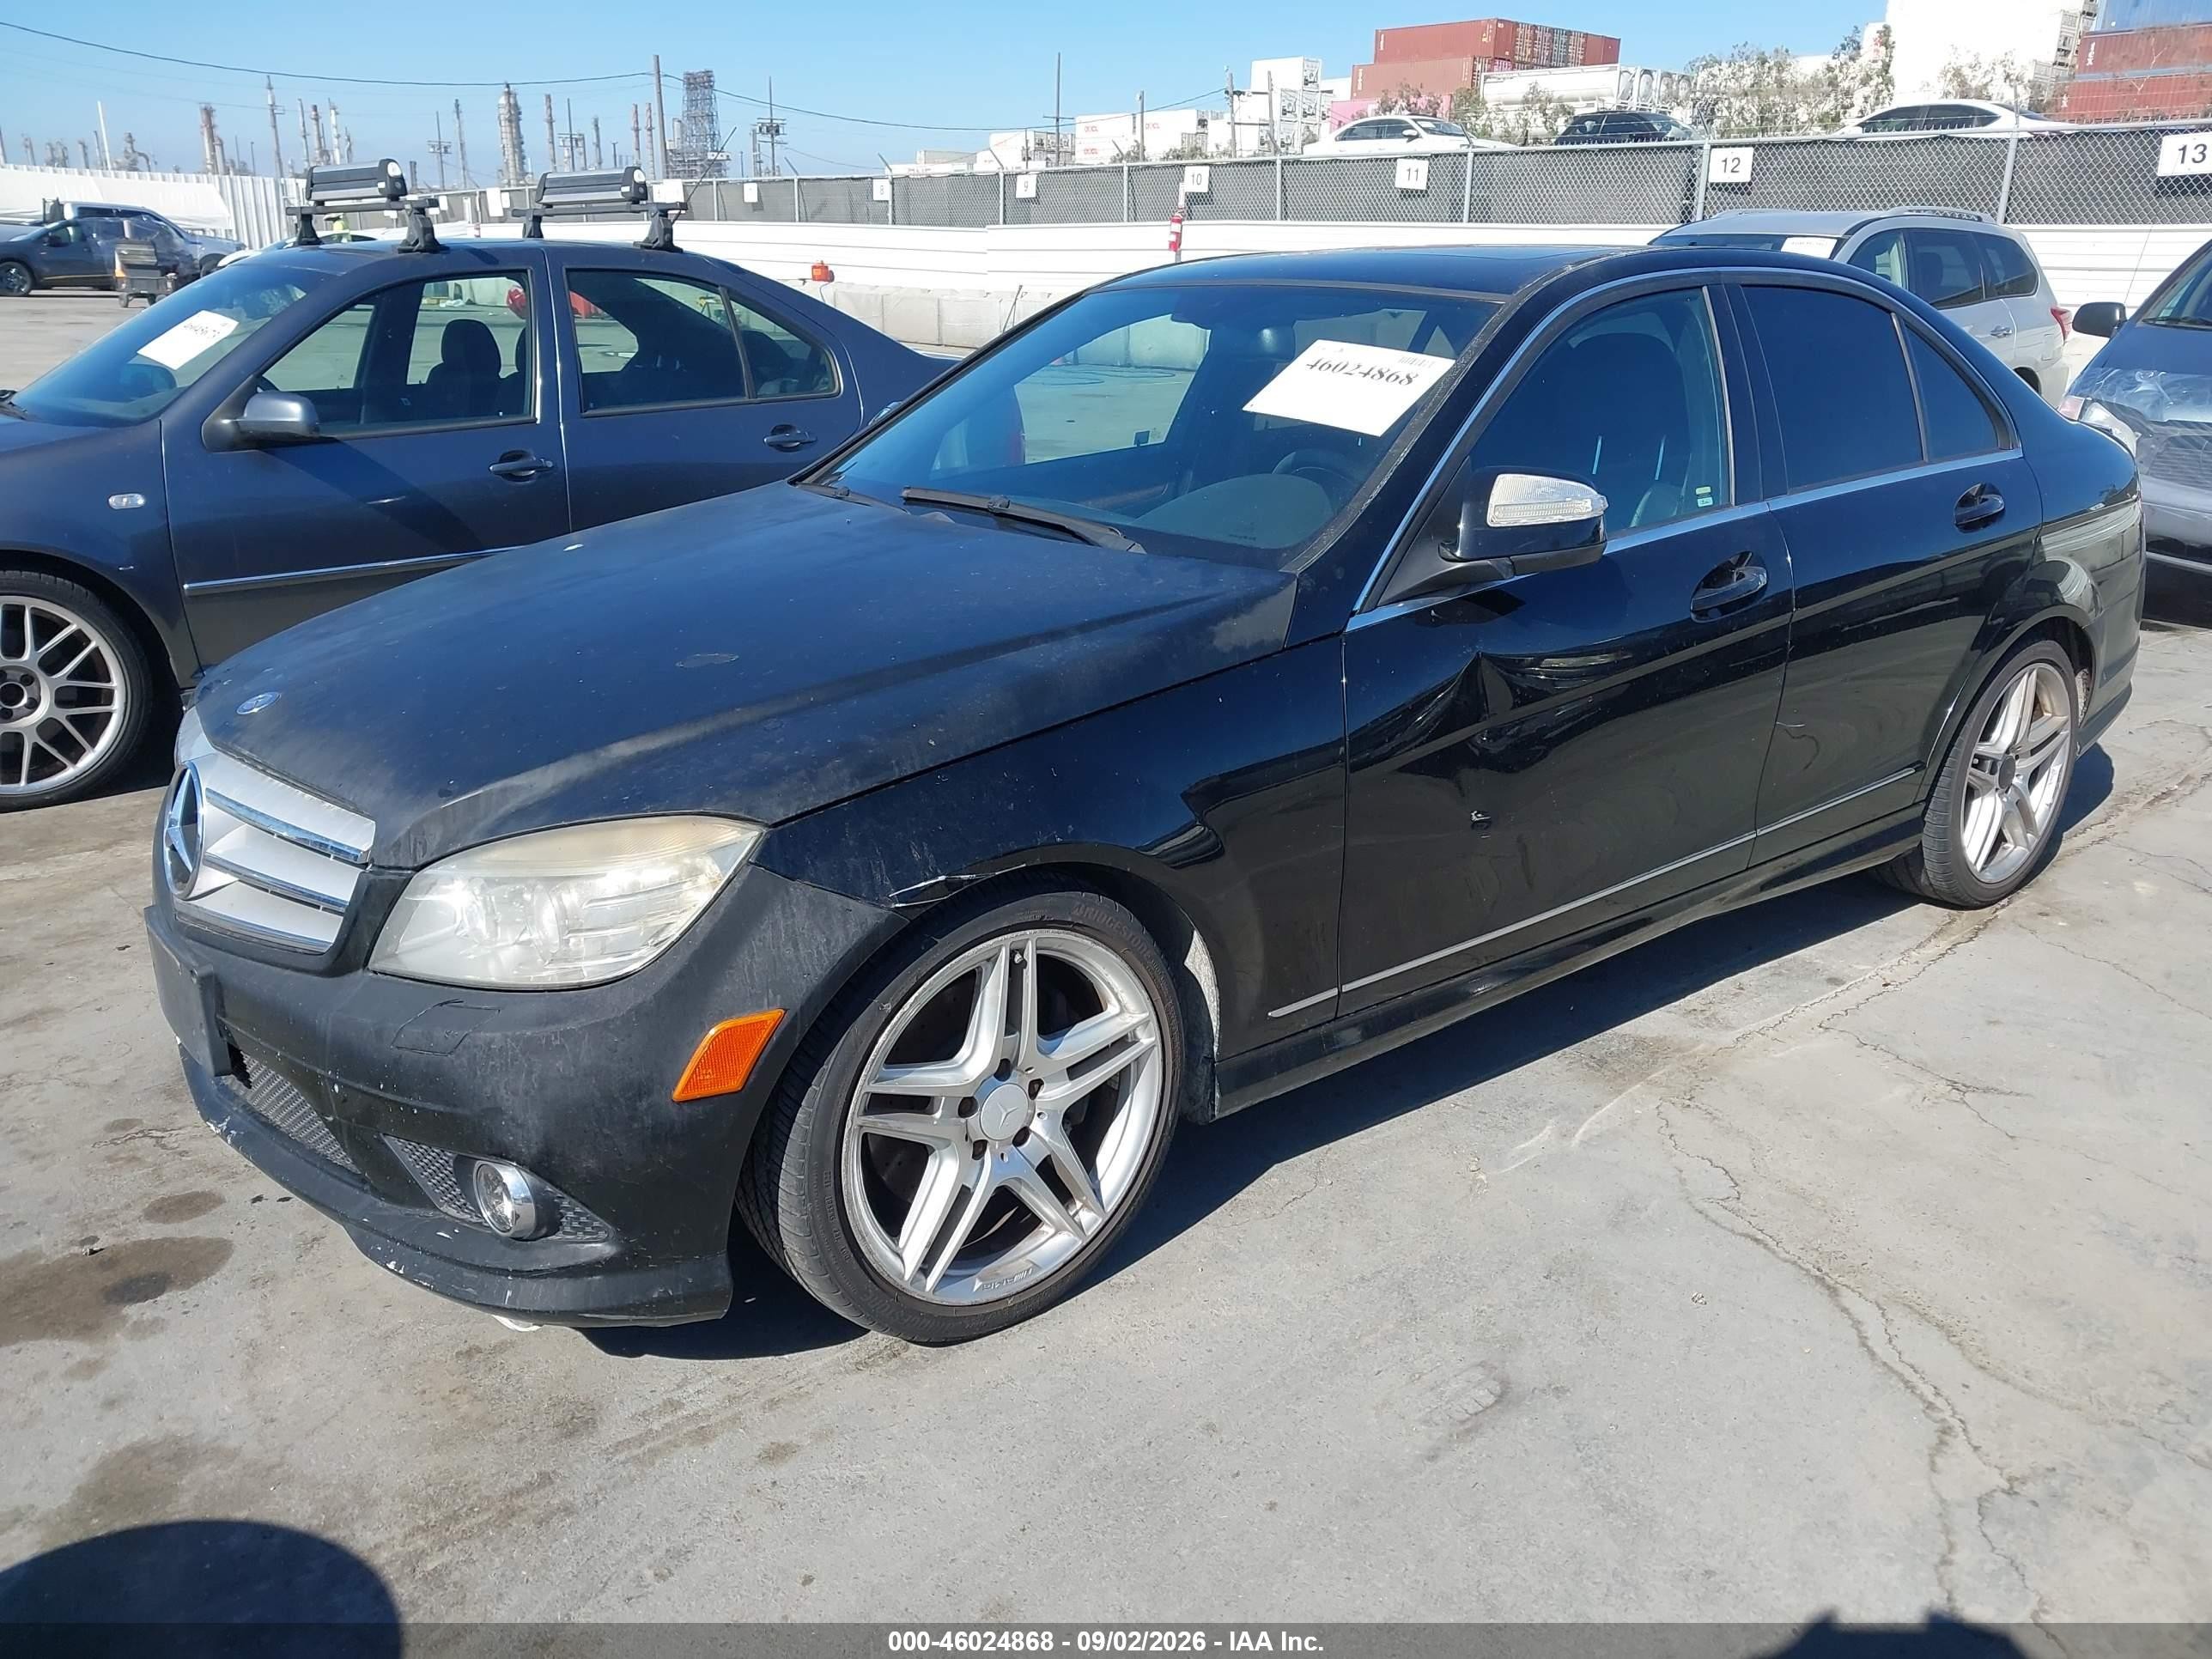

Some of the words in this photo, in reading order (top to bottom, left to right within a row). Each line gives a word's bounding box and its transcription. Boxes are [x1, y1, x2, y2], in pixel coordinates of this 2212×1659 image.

[2178, 143, 2208, 165] 13
[1721, 157, 1741, 173] 12
[1191, 172, 1202, 185] 10
[1406, 167, 1419, 181] 11
[879, 185, 884, 195] 8
[1024, 180, 1029, 192] 9
[1305, 357, 1419, 386] 46024868
